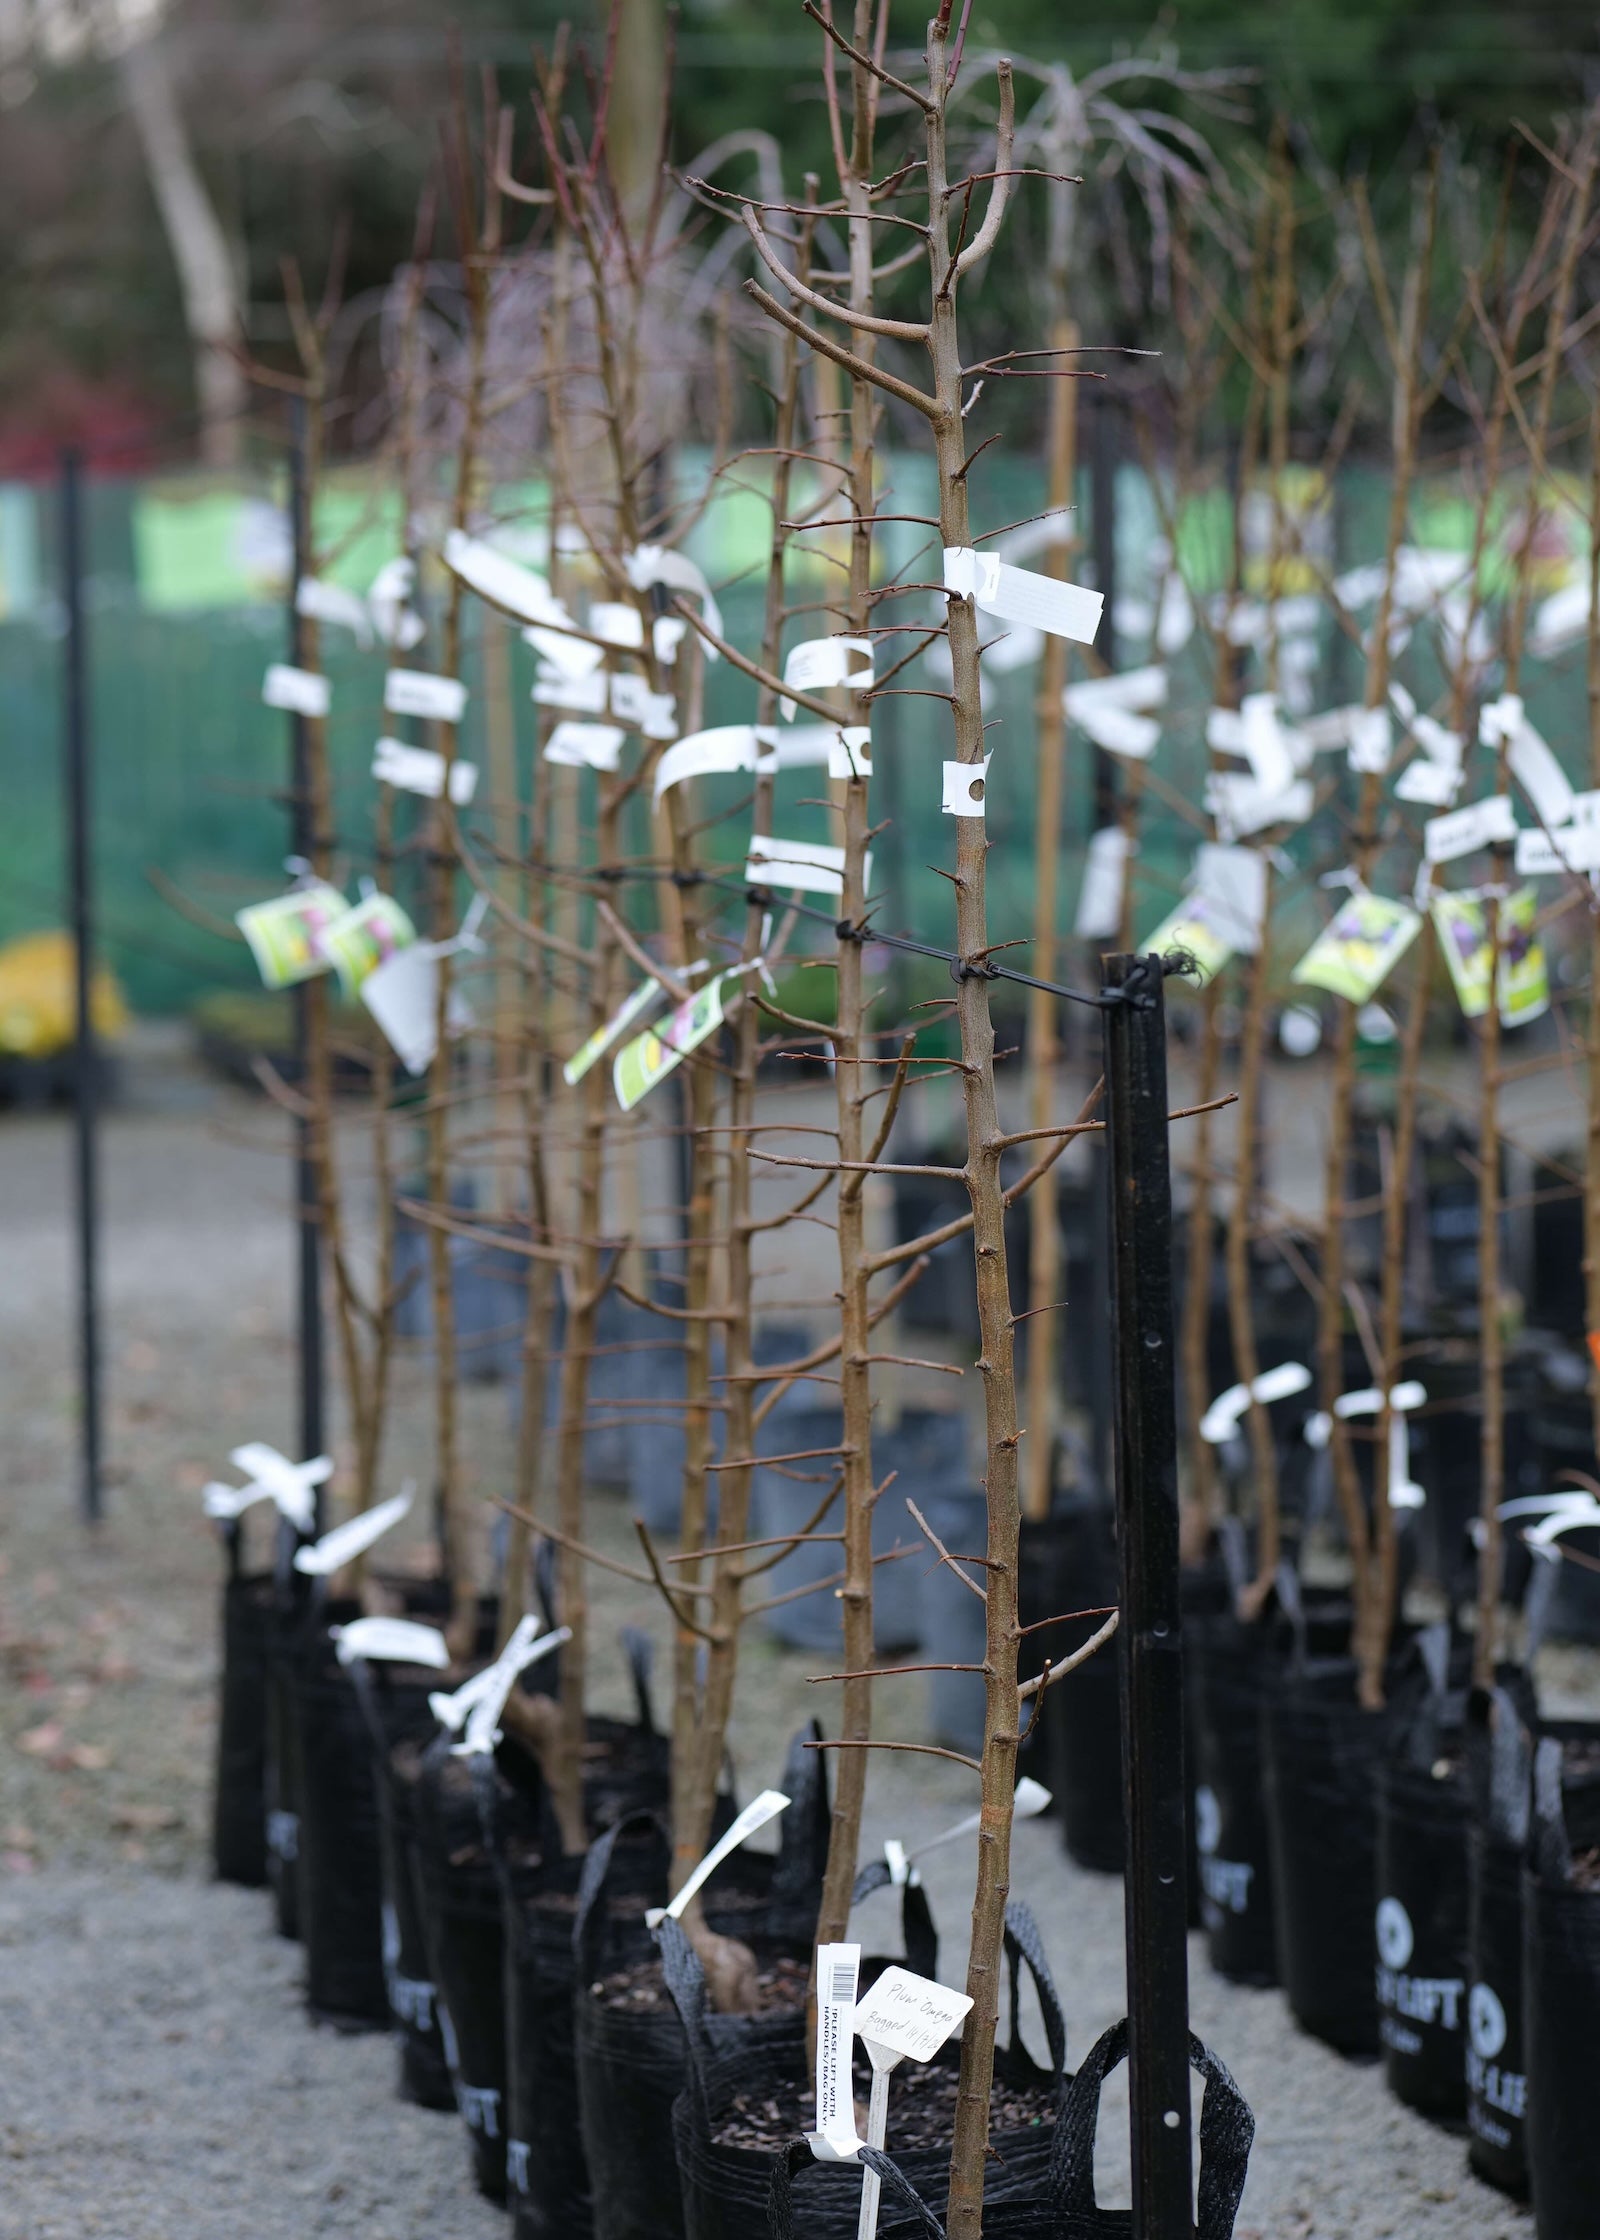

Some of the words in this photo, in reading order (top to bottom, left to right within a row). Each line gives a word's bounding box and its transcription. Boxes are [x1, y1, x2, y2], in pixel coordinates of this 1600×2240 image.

[886, 1983, 918, 2004] Plum
[865, 2010, 911, 2034] Bagged
[822, 2005, 830, 2089] HANDLES/BAG
[829, 2056, 838, 2083] LIFT
[821, 2092, 829, 2126] ONLY!
[829, 2086, 837, 2118] WITH
